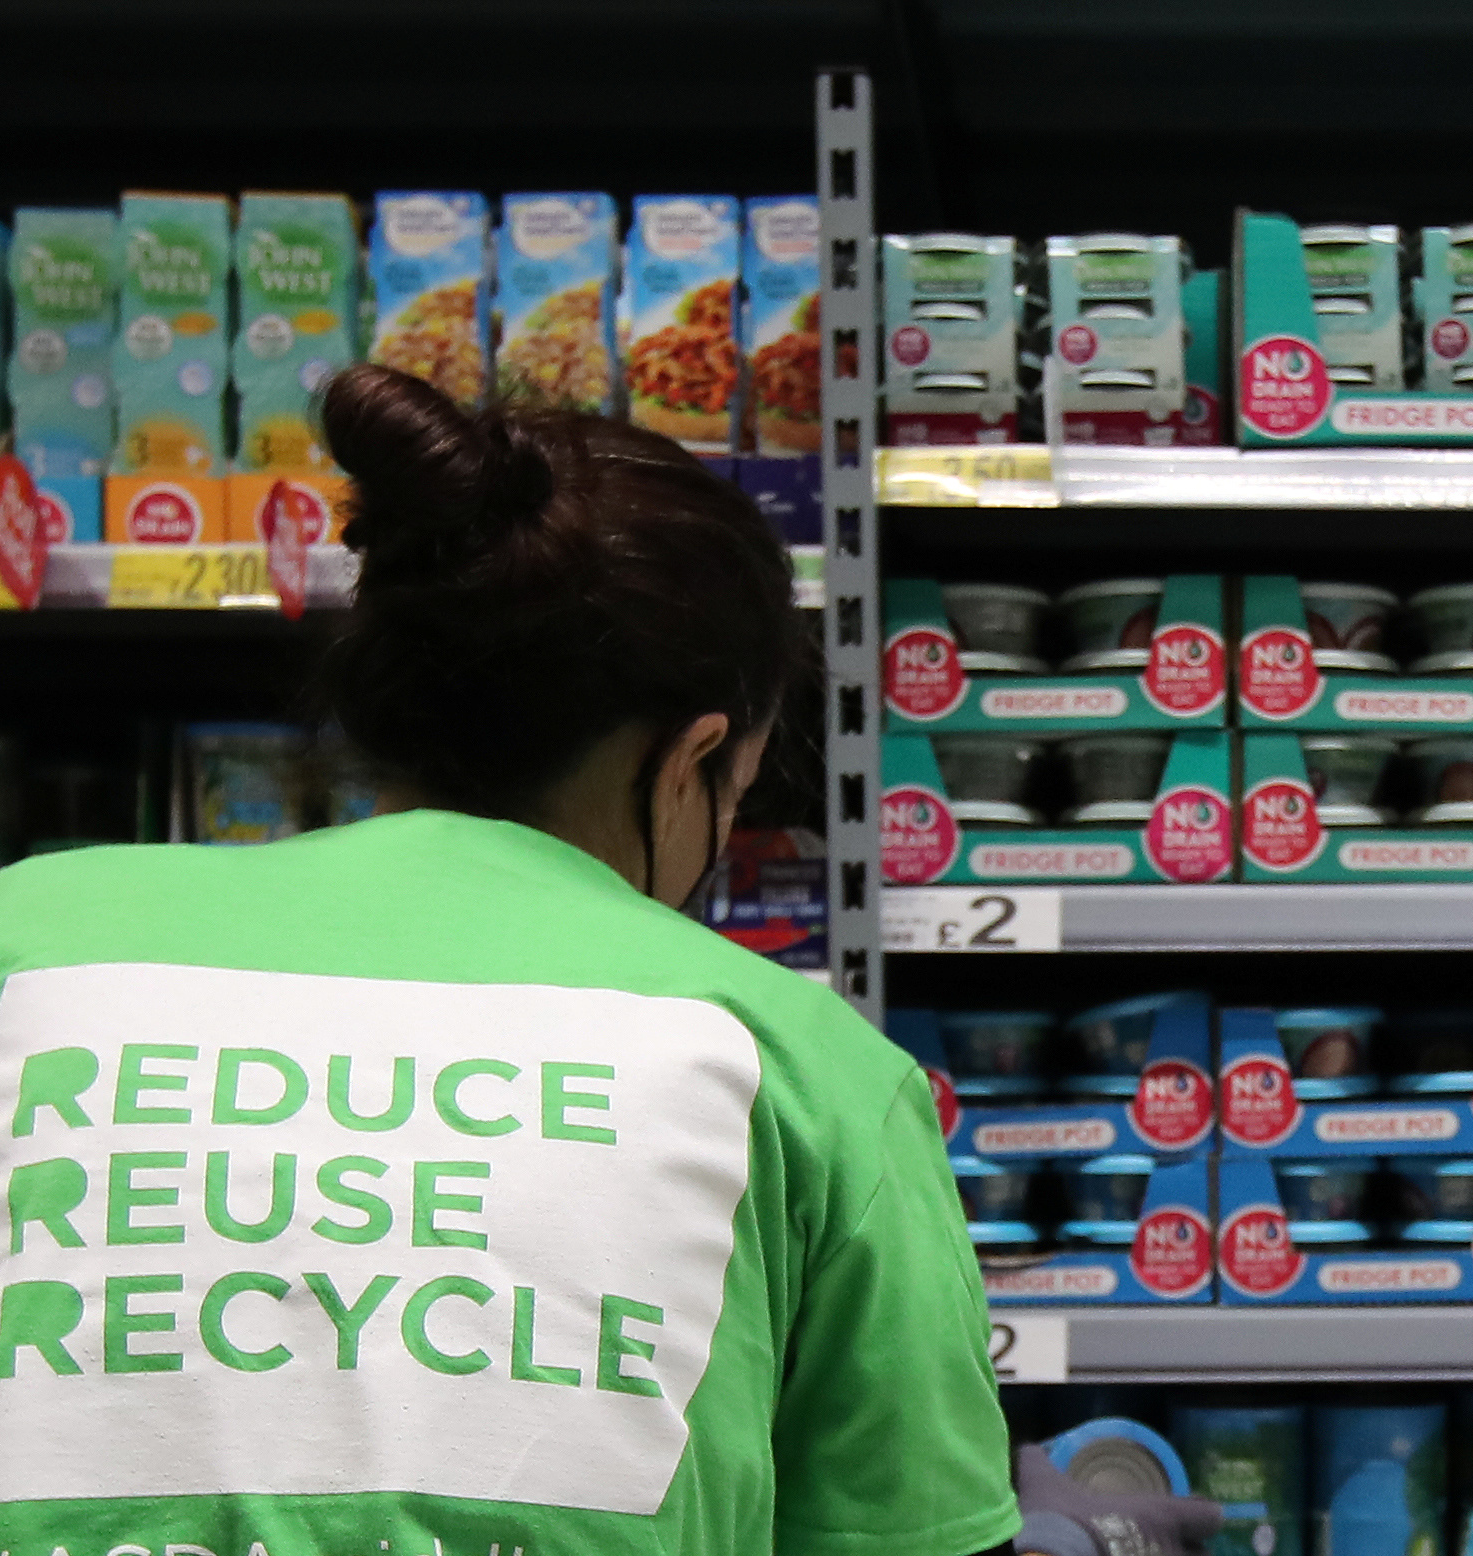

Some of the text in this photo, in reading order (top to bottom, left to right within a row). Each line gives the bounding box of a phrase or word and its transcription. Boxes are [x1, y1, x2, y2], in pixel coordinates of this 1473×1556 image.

[1252, 350, 1311, 381] NO
[1252, 381, 1314, 399] DRAIN
[1345, 406, 1434, 427] FRIDGE
[894, 642, 948, 669] NO
[1158, 640, 1210, 668] NO
[1249, 642, 1303, 670] NO
[1163, 799, 1218, 828] NO
[1253, 793, 1305, 820] NO
[1430, 845, 1472, 866] POT
[937, 896, 1017, 948] £2
[11, 1042, 618, 1146] REDUCE
[1145, 1073, 1196, 1097] NO
[1230, 1072, 1282, 1095] NO
[1408, 1115, 1445, 1135] POT
[8, 1151, 492, 1256] REUSE
[1145, 1224, 1196, 1247] NO
[1236, 1224, 1284, 1248] NO
